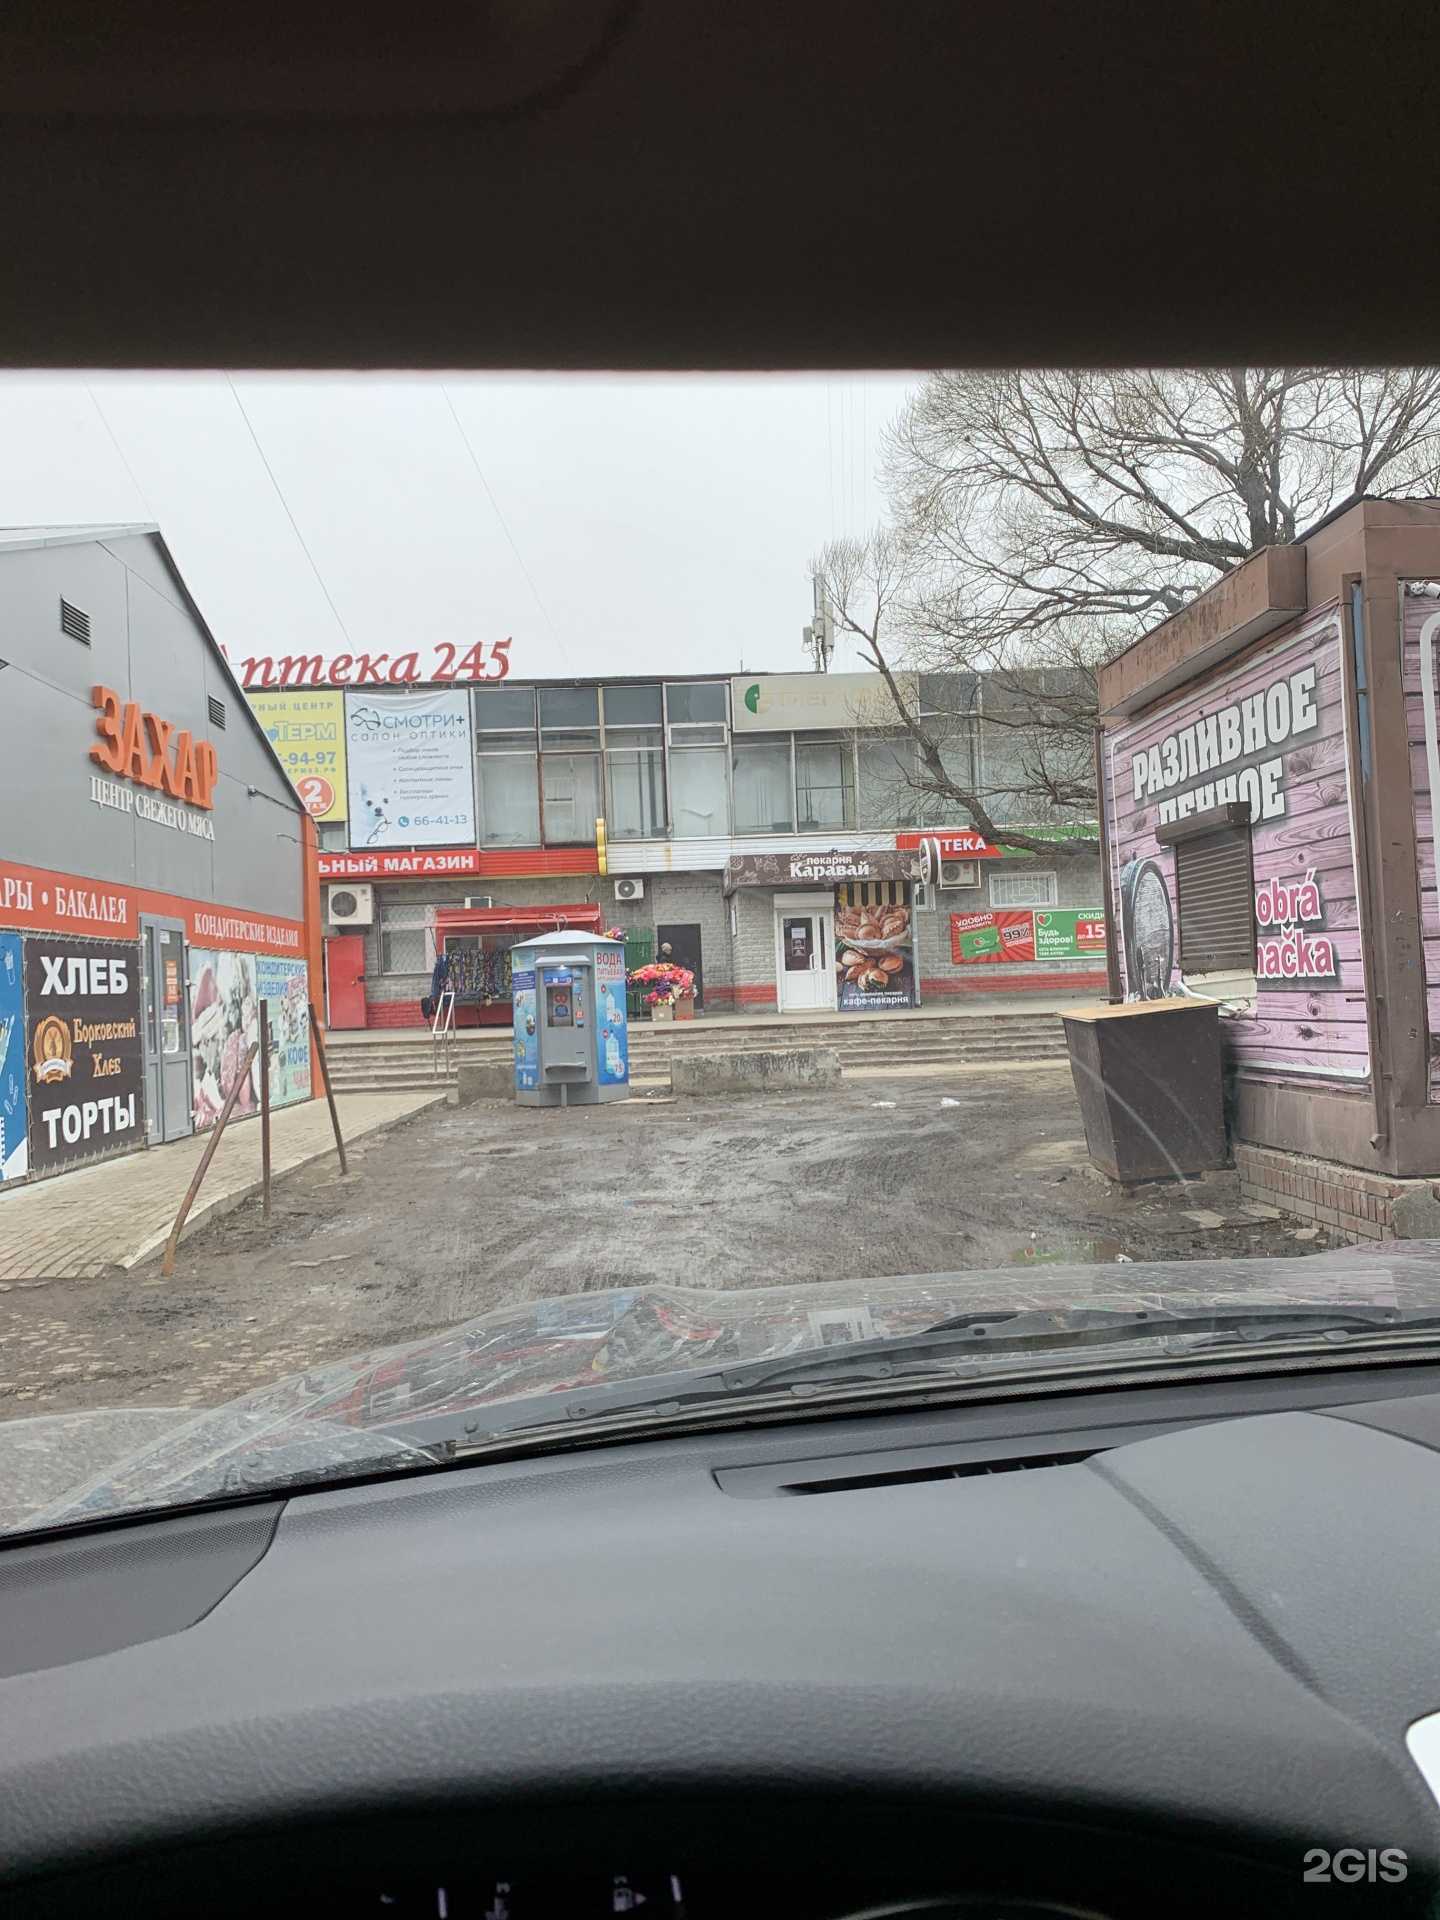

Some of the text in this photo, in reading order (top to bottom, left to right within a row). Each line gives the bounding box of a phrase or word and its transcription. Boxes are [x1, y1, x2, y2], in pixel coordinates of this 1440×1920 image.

[221, 637, 512, 688] птека 245
[351, 730, 466, 742] салон оптики
[1132, 664, 1318, 801] РАЗЛИВНОЕ
[89, 686, 218, 810] ЗАХАР
[303, 780, 323, 803] 2
[89, 776, 216, 841] ЦЕНТР СВЕЖЕГО МЯСА
[414, 815, 468, 826] 66-41-13
[940, 837, 986, 852] ТЕКА
[318, 855, 474, 873] ЬНЫЙ МАГАЗИН
[790, 861, 870, 880] Каравай
[806, 856, 852, 866] пекарня
[55, 886, 128, 924] БАКАЛЕЯ
[1255, 867, 1322, 926] obrá
[194, 912, 299, 948] КОНДИТЕРСКИЕ ИЗДЕЛИЯ
[955, 913, 993, 927] УДОБНО
[1038, 928, 1060, 938] Будь
[1039, 935, 1073, 946] здоров!
[596, 952, 623, 966] ВОДА
[40, 956, 129, 996] ХЛЕБ
[843, 996, 909, 1007] кафе-пекарня
[73, 1018, 136, 1049] Борковский
[43, 1093, 136, 1149] ТОРТЫ
